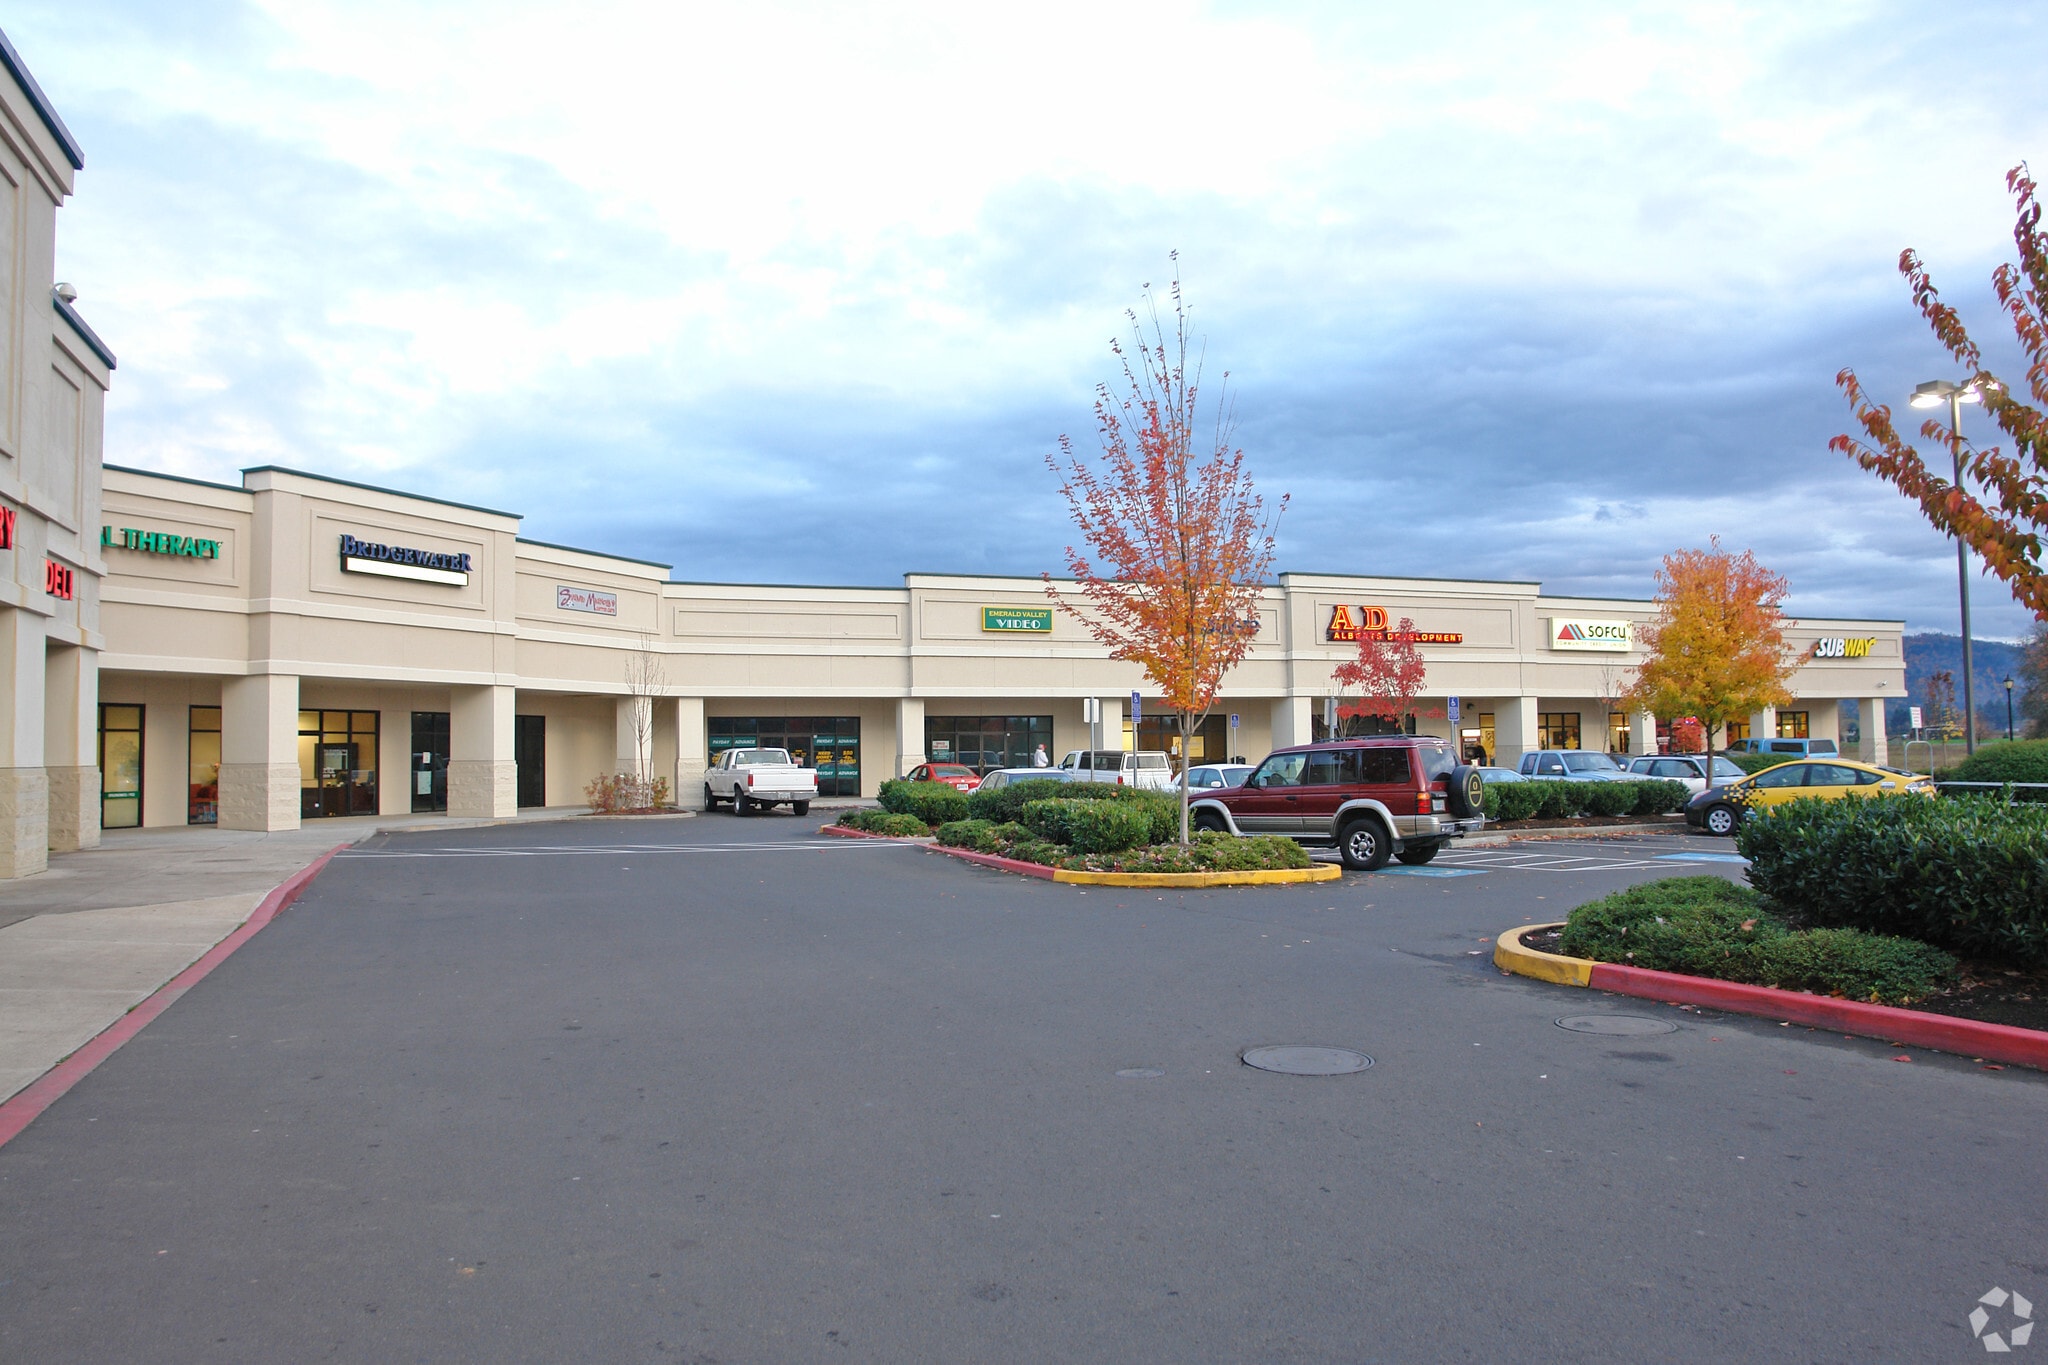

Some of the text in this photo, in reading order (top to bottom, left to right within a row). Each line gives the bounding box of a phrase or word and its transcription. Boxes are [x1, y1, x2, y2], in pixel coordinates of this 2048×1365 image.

[121, 528, 223, 560] THERAPY
[341, 534, 473, 572] BRIDGEWATER
[46, 559, 73, 600] DELI
[996, 618, 1041, 629] VIDEO
[1588, 625, 1627, 639] SOFCU
[1387, 633, 1463, 642] DEELOPMENT
[1815, 637, 1878, 657] SUBWAY
